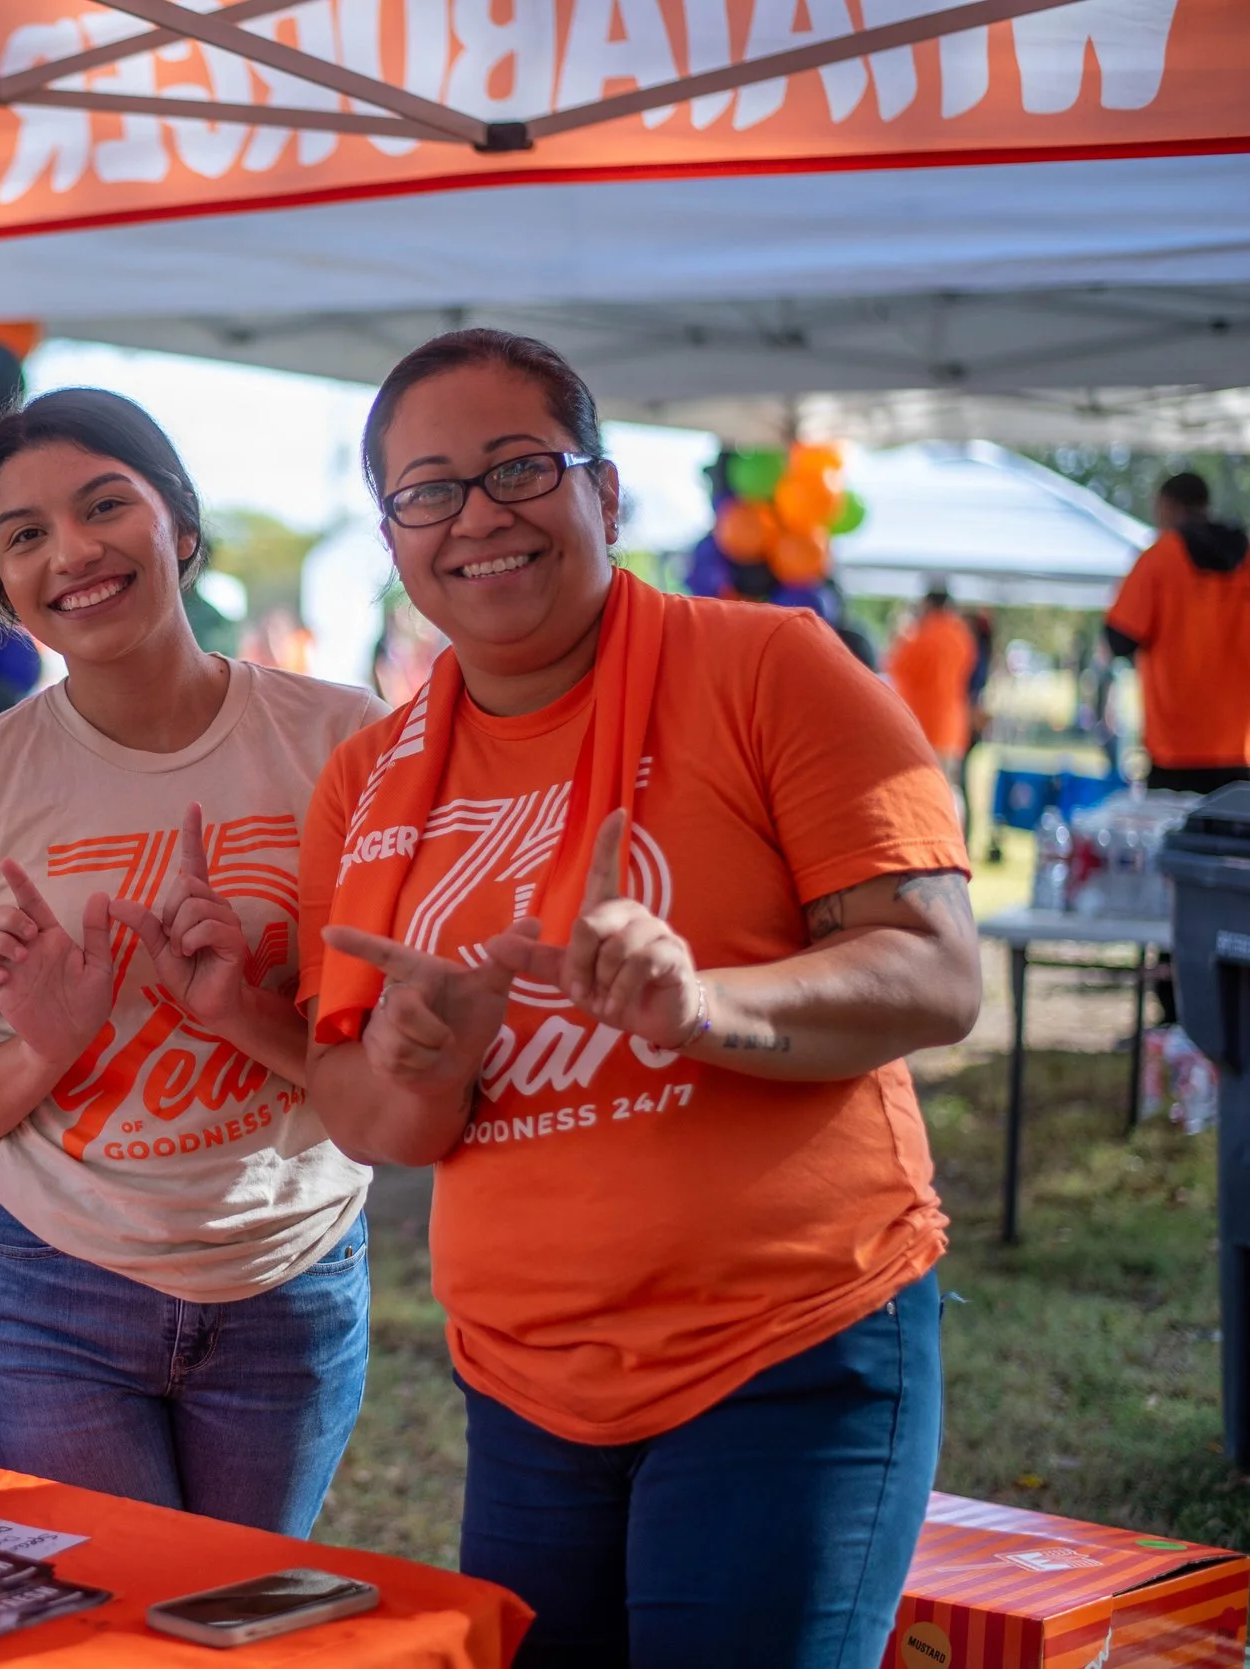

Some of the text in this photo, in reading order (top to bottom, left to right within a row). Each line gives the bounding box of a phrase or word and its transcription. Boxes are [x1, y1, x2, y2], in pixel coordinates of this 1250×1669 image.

[51, 1001, 268, 1162] Yea
[103, 1104, 272, 1160] GOODNESS
[121, 1120, 143, 1134] OF
[463, 1083, 694, 1144] OODNESS 24/7
[907, 1635, 946, 1665] MUSTARD
